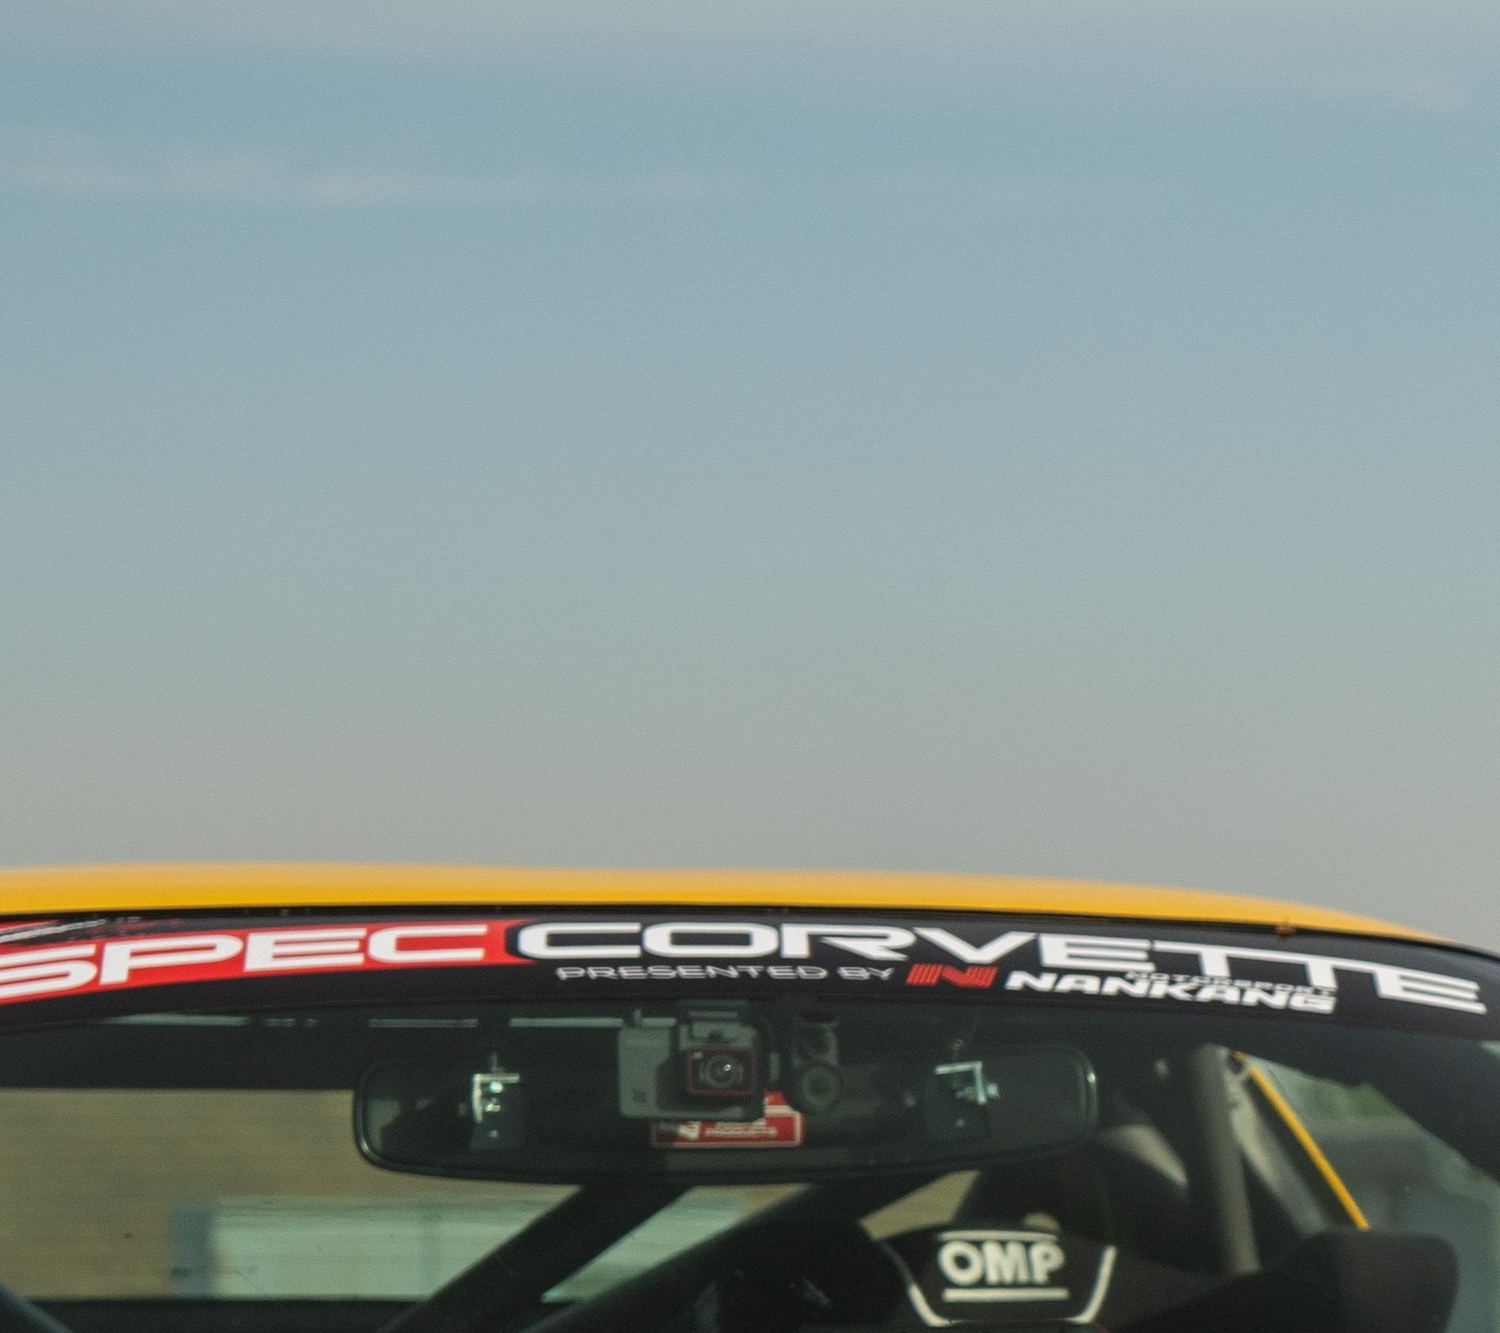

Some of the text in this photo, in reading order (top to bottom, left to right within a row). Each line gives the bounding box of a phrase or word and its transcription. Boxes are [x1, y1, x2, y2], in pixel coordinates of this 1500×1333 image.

[517, 921, 1487, 1016] CORVETTE
[554, 965, 894, 981] PRESENTED BY
[1004, 970, 1338, 1015] NANKANG
[937, 1240, 1066, 1286] OMP
